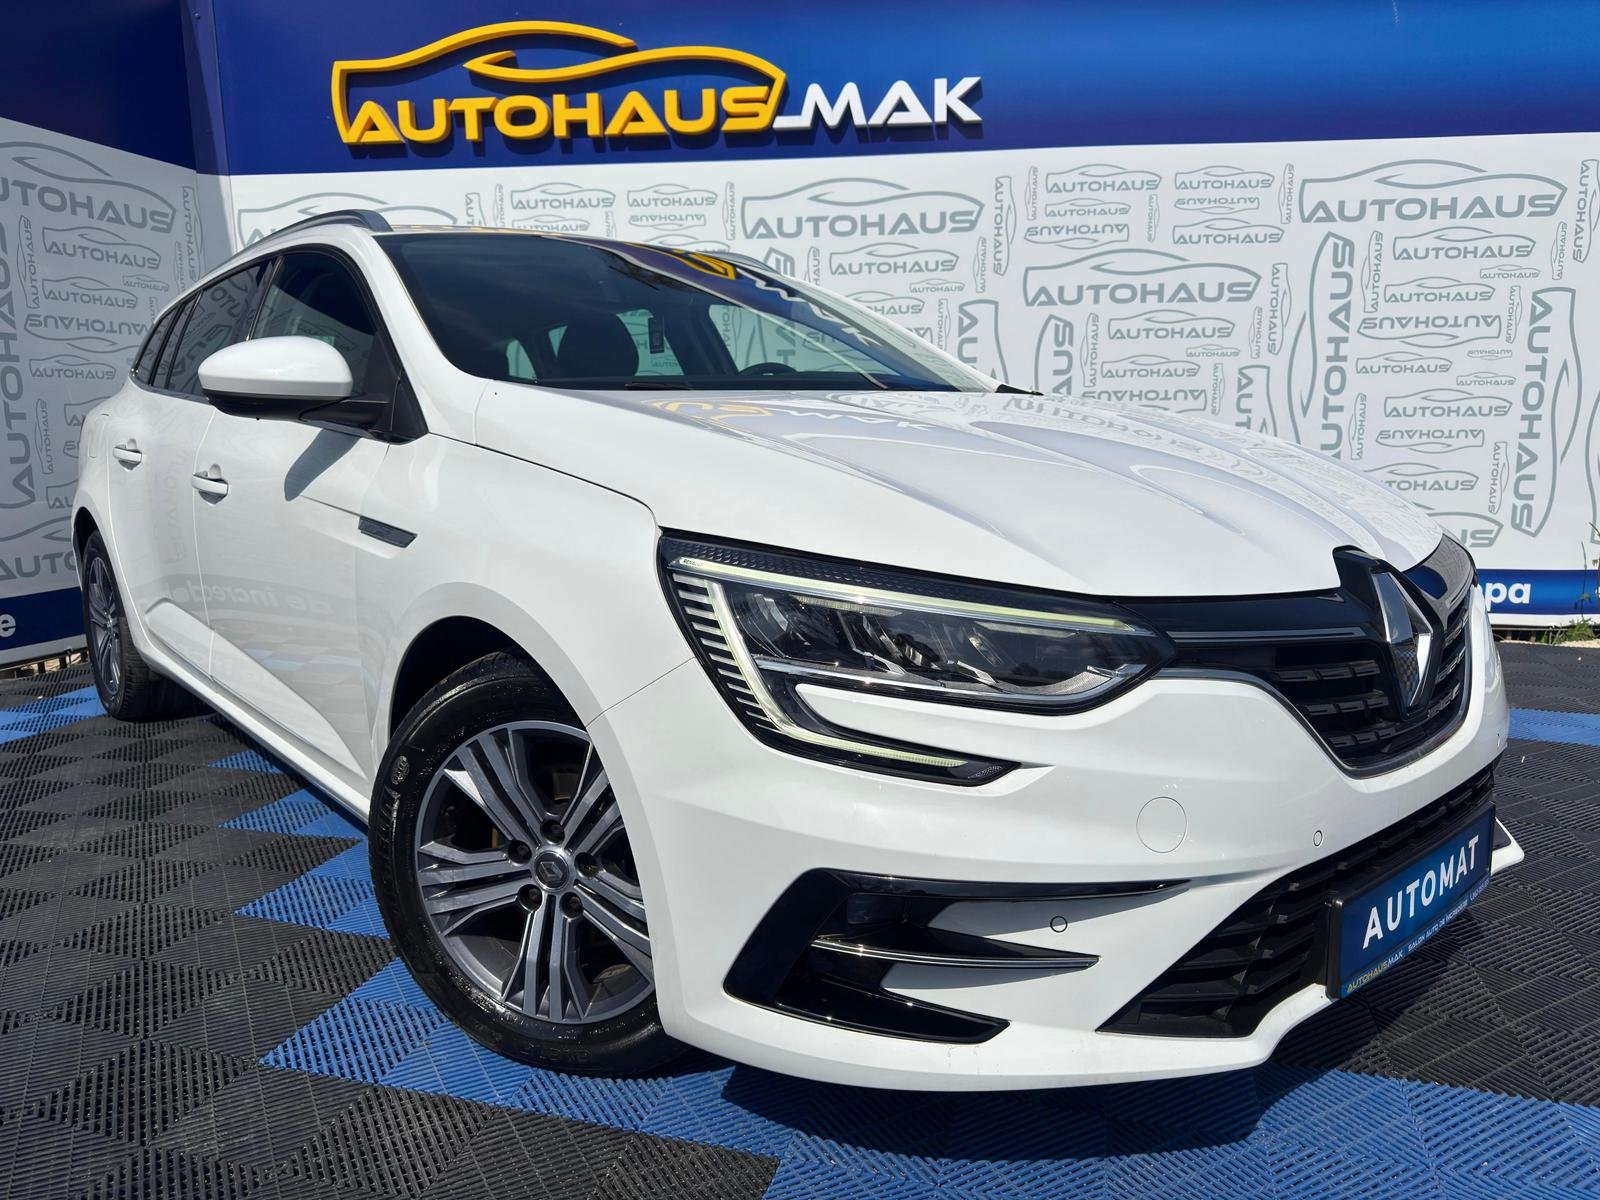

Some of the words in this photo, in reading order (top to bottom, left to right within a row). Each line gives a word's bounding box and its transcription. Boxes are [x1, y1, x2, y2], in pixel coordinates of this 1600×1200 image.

[1048, 179, 1159, 193] AUTOHAUS
[1176, 178, 1273, 190] AUTOHAUS
[1286, 163, 1295, 223] AUTOHAUS
[513, 197, 615, 210] AUTOHAUS
[629, 196, 716, 208] AUTOHAUS
[728, 182, 736, 240] AUTOHAUS
[1176, 197, 1258, 206] AUTOHAUS
[1304, 194, 1556, 223] AUTOHAUS
[631, 214, 705, 223] AUTOHAUS
[1046, 206, 1130, 217] AUTOHAUS
[1573, 160, 1590, 263] AUTOHAUS
[747, 210, 980, 240] AUTOHAUS
[993, 176, 1005, 277] AUTOHAUS
[1027, 224, 1128, 237] AUTOHAUS
[1175, 232, 1281, 245] AUTOHAUS
[47, 240, 160, 270] AUTOHAUS
[1395, 244, 1533, 261] AUTOHAUS
[1556, 222, 1567, 280] AUTOHAUS
[24, 217, 40, 309] AUTOHAUS
[832, 259, 957, 275] AUTOHAUS
[979, 237, 987, 293] AUTOHAUS
[1370, 231, 1383, 313] AUTOHAUS
[1481, 271, 1540, 279] AUTOHAUS
[45, 288, 137, 309] AUTOHAUS
[910, 285, 965, 293] AUTOHAUS
[1029, 281, 1256, 307] AUTOHAUS
[1385, 290, 1494, 303] AUTOHAUS
[1267, 263, 1281, 356] AUTOHAUS
[1506, 286, 1517, 344] AUTOHAUS
[1362, 314, 1500, 330] AUTOHAUS
[1111, 326, 1232, 340] AUTOHAUS
[1254, 307, 1263, 358] AUTOHAUS
[1090, 313, 1100, 386] AUTOHAUS
[32, 367, 116, 380] AUTOHAUS
[1103, 367, 1198, 379] AUTOHAUS
[1358, 363, 1450, 374] AUTOHAUS
[1386, 405, 1509, 418] AUTOHAUS
[1511, 290, 1553, 537] AUTOHAUS
[1356, 394, 1367, 459] AUTOHAUS
[1379, 429, 1483, 440] AUTOHAUS
[1488, 441, 1501, 515] AUTOHAUS
[1362, 834, 1479, 950] AUTOMAT
